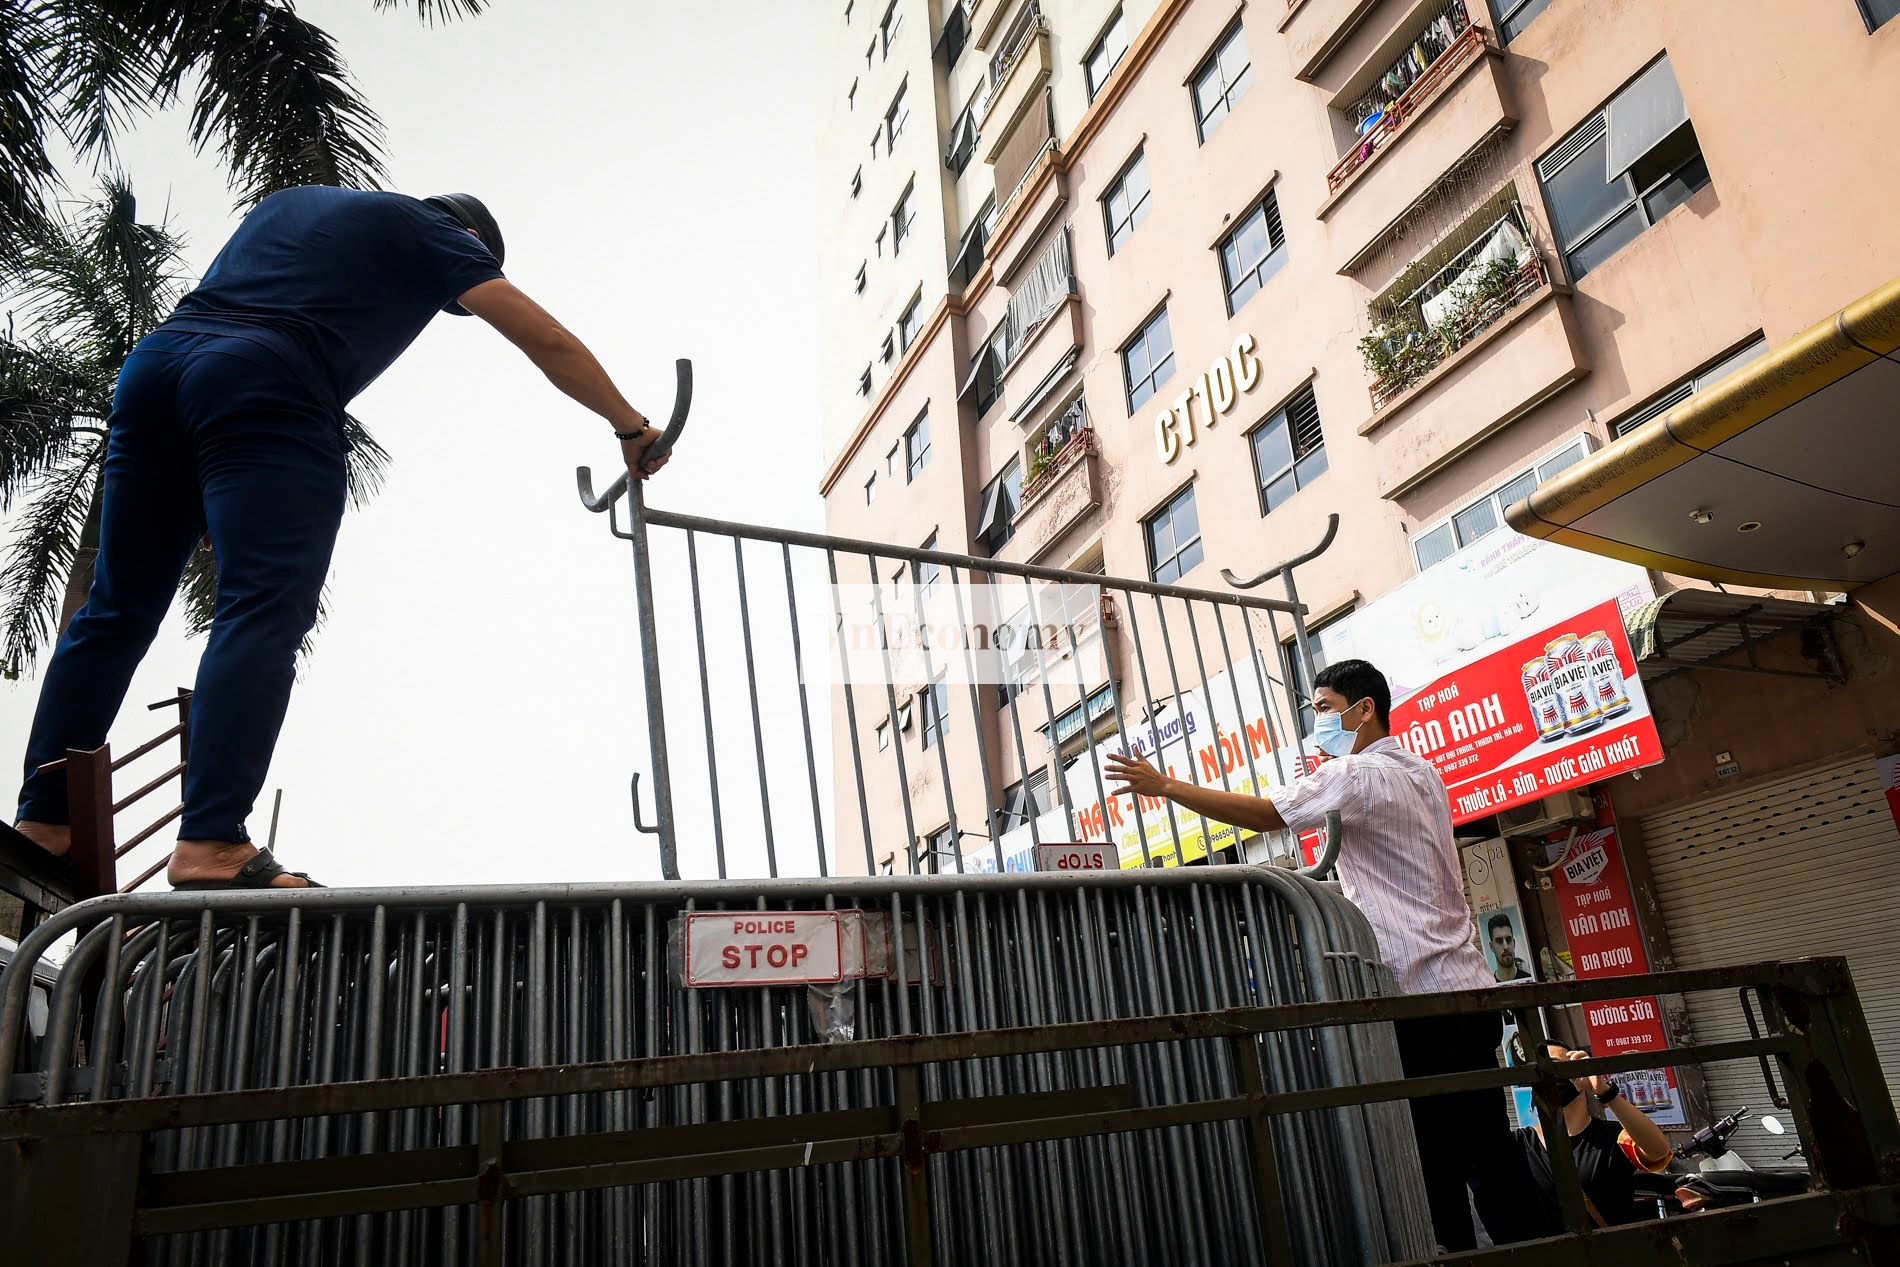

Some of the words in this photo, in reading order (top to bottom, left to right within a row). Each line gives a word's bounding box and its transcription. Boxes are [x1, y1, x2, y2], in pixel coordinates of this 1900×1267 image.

[1155, 333, 1262, 465] CT10C
[1554, 673, 1569, 690] BIA
[1567, 665, 1588, 682] VIỆT
[1417, 694, 1435, 712] TẠP
[1437, 682, 1459, 704] HOÁ
[1530, 687, 1542, 703] BIA
[1394, 720, 1446, 755] VÂN
[1448, 693, 1505, 743] ANH
[1492, 779, 1507, 804] LÁ
[1512, 771, 1538, 797] BỈM
[1544, 755, 1579, 785] NƯỚC
[1579, 746, 1606, 774] GIẢI
[1605, 734, 1641, 765] KHÁT
[1078, 794, 1124, 843] HAR
[1057, 853, 1103, 869] STOP
[1469, 845, 1504, 886] Spa
[1566, 862, 1584, 880] BIA
[1583, 849, 1604, 868] VIỆT
[1575, 893, 1591, 907] TẠP
[1594, 886, 1611, 903] HOÁ
[734, 920, 795, 934] POLICE
[1569, 913, 1598, 937] VÂN
[1600, 907, 1630, 931] ANH
[722, 944, 808, 969] STOP
[1581, 953, 1601, 971] BIA
[1601, 947, 1632, 968] RƯỢU
[1589, 1005, 1628, 1027] ĐƯỜNG
[1629, 1000, 1654, 1021] SỮA
